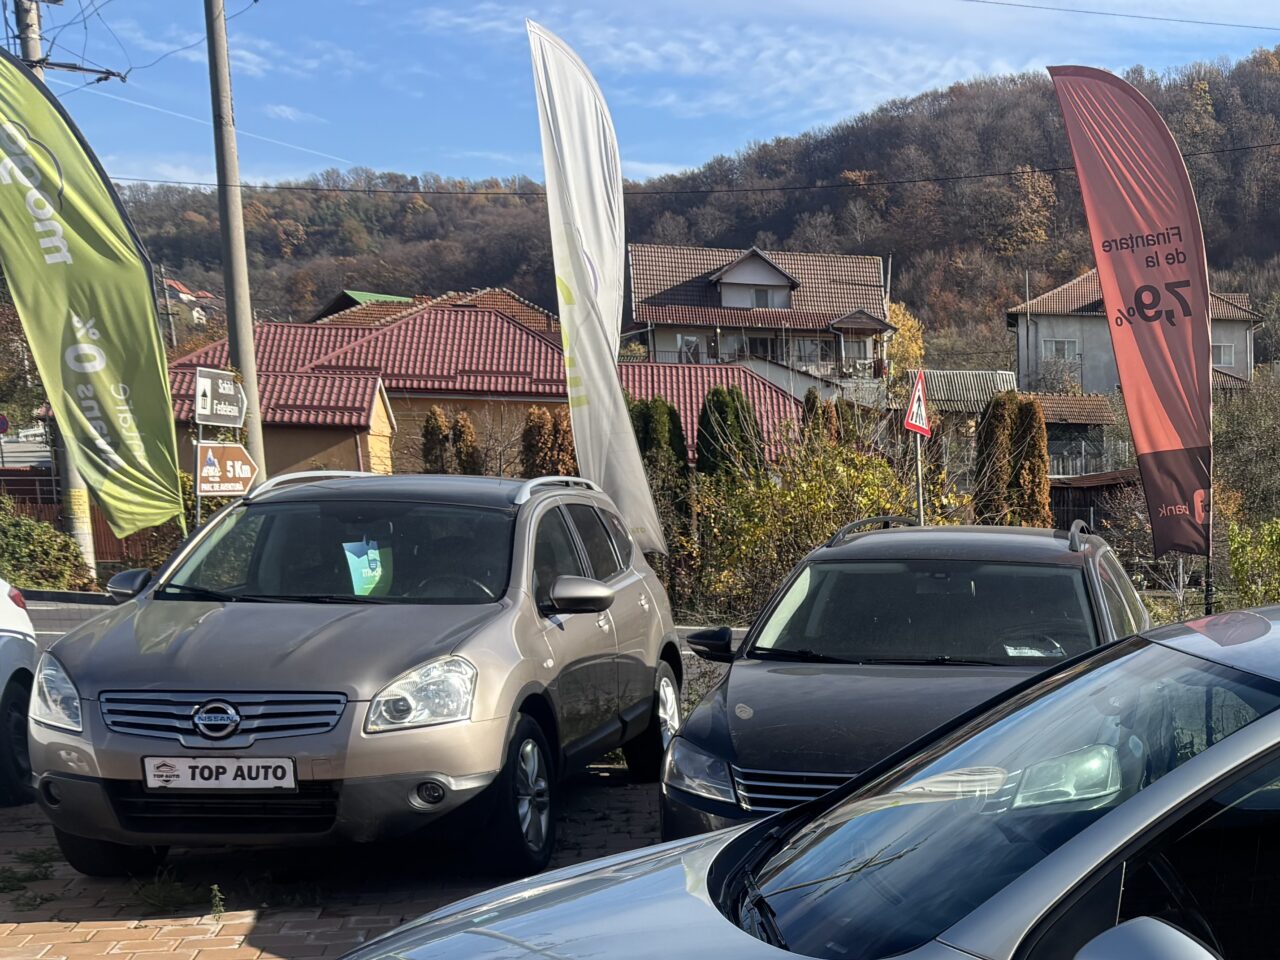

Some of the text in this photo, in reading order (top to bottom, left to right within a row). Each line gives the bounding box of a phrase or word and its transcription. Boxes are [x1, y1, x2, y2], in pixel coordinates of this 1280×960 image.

[226, 461, 234, 478] 5
[234, 461, 252, 477] Km
[196, 713, 234, 723] NISSAN
[188, 764, 287, 781] TOP AUTO
